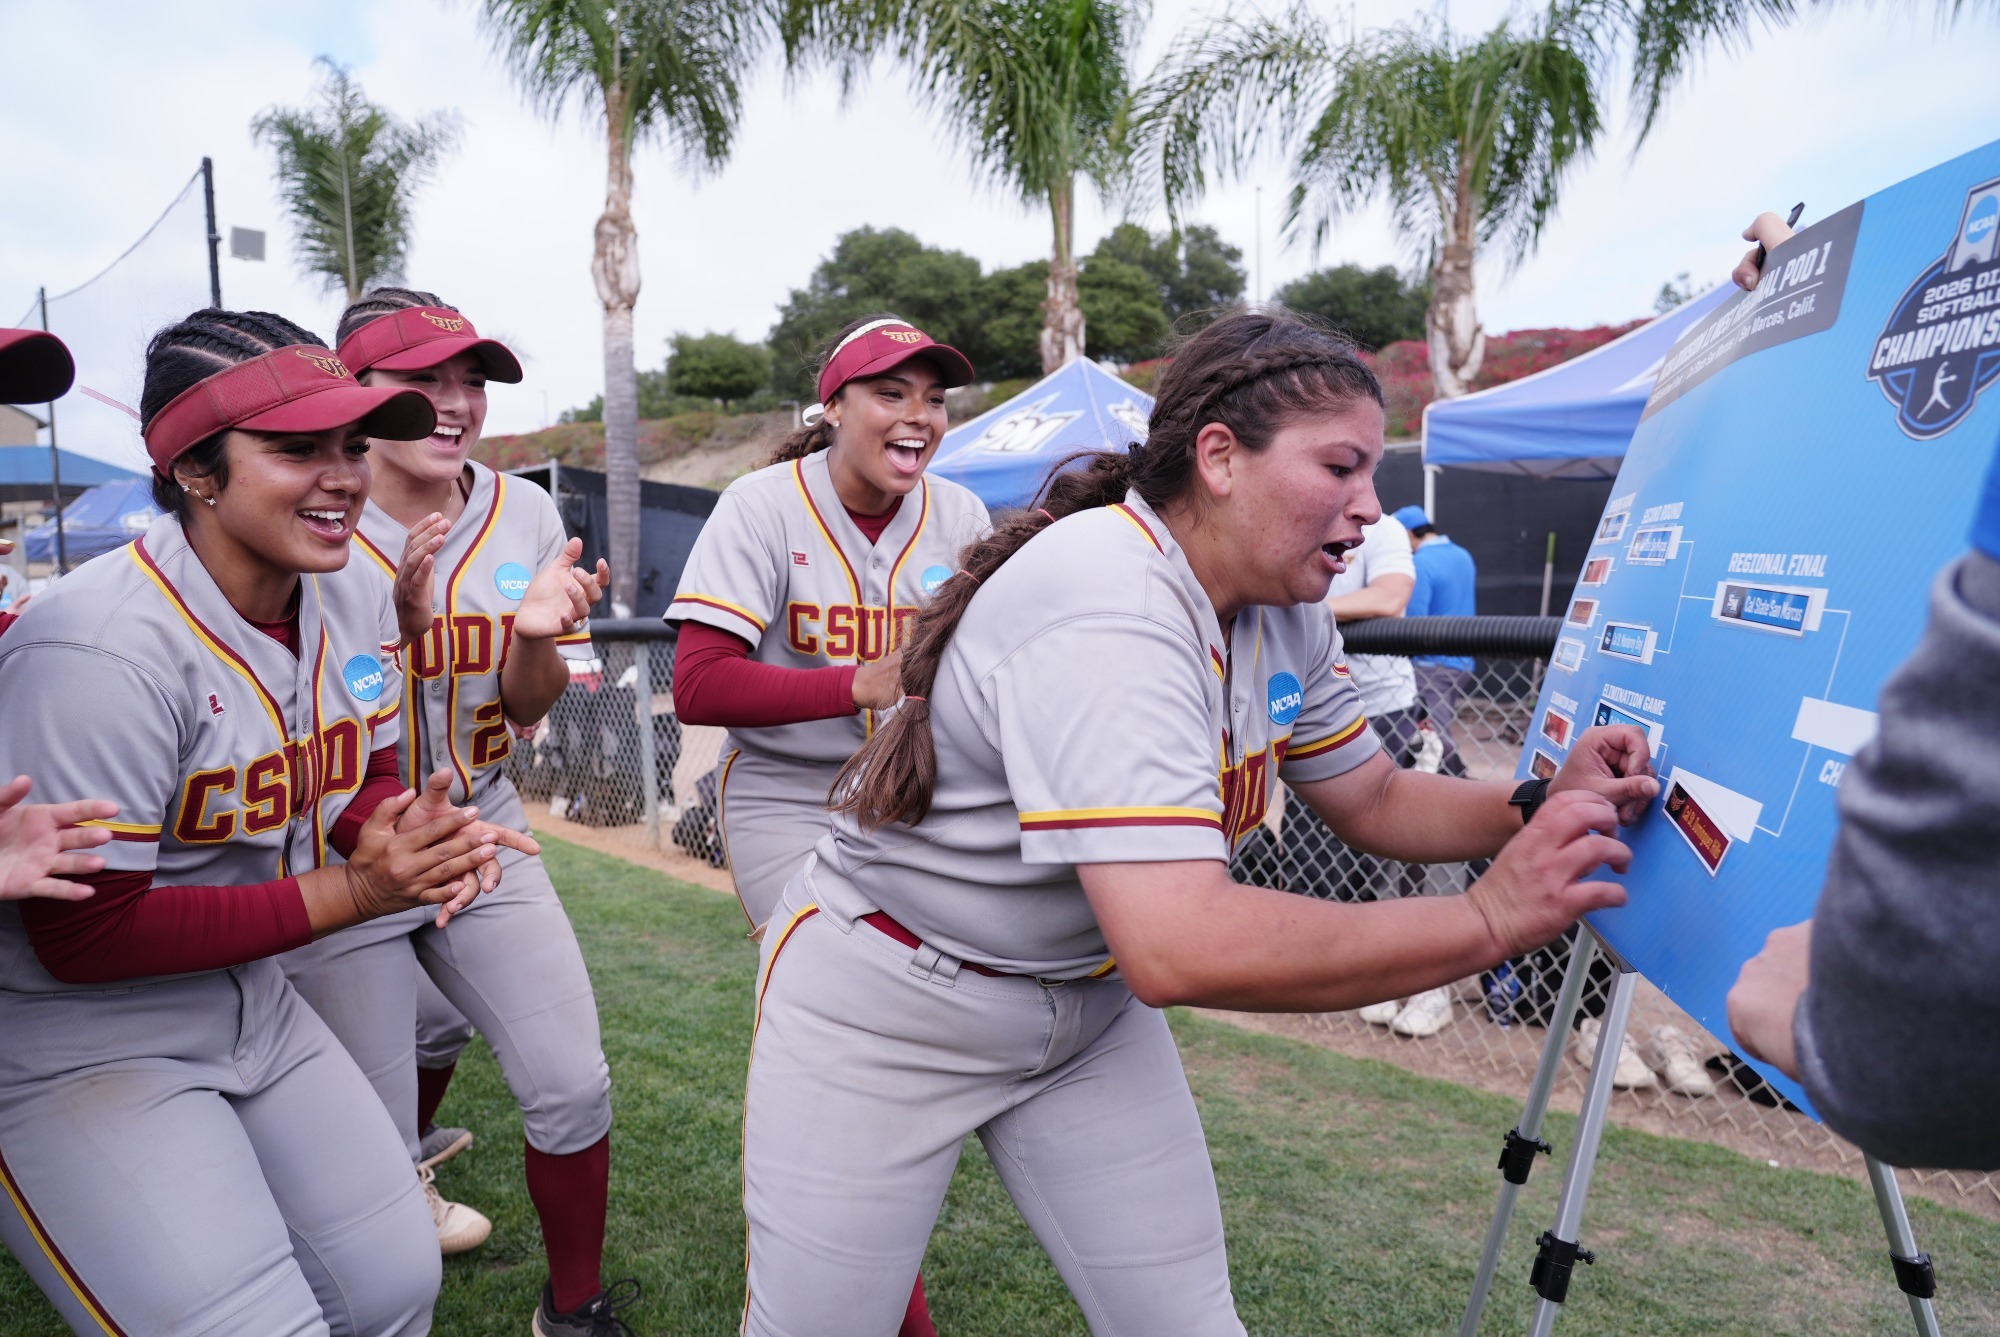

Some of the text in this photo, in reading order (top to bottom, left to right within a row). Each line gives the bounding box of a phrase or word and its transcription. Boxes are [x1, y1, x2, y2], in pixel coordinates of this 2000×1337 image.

[1778, 248, 1819, 292] POD
[1814, 241, 1832, 276] 1
[1923, 268, 2000, 305] 2026 DI
[1787, 294, 1816, 320] Calif.
[1873, 309, 2000, 370] CHAMPIONS
[1728, 552, 1828, 578] REGIONAL FINAL
[352, 672, 383, 693] NCAA
[1270, 692, 1302, 716] NCAA
[1602, 683, 1643, 709] ELIMINATION
[1642, 694, 1667, 717] GAME
